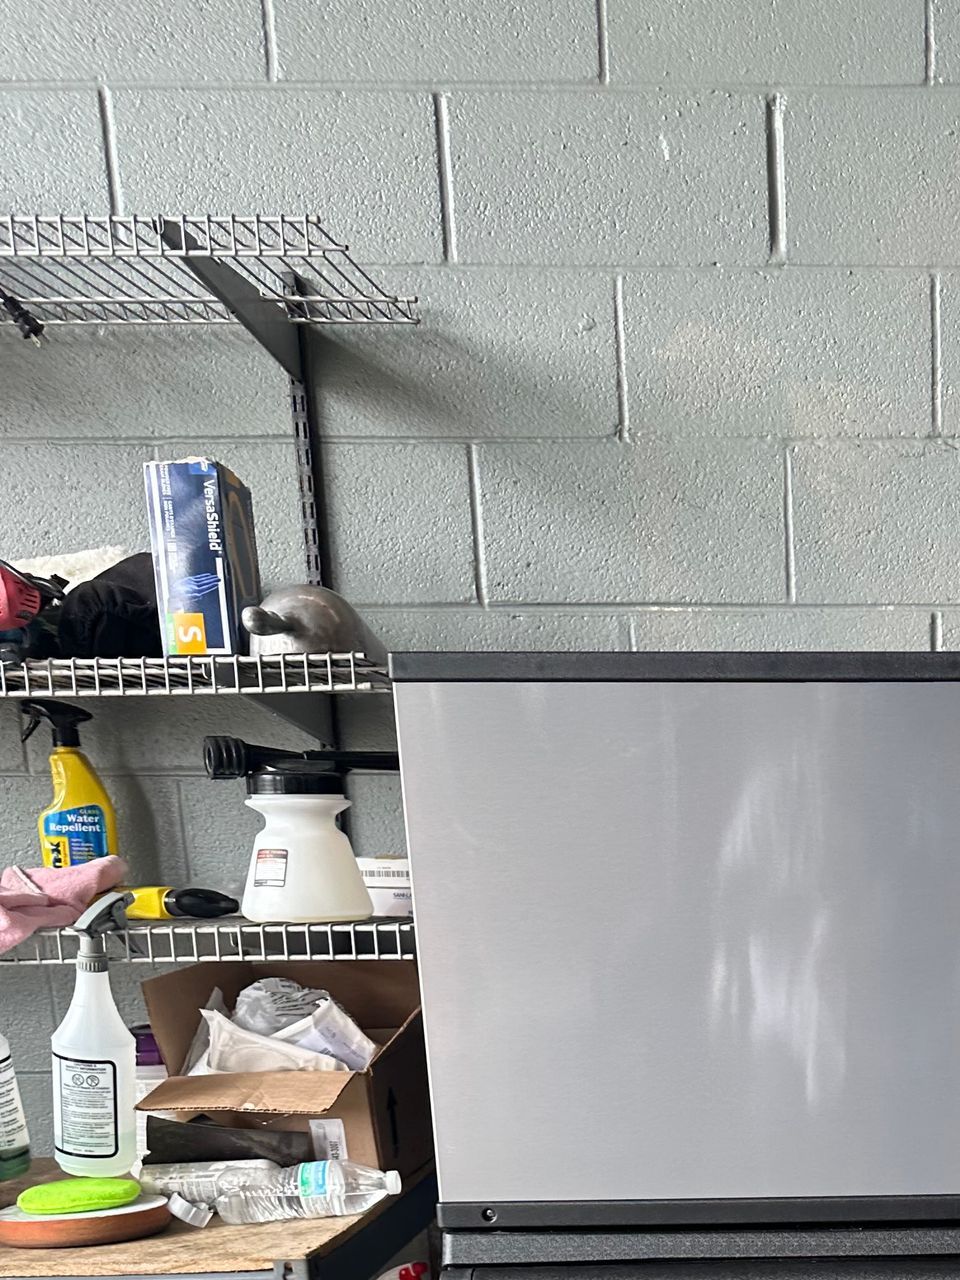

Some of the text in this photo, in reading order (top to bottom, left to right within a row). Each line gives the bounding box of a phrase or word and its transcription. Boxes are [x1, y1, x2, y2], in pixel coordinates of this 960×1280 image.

[203, 480, 222, 551] VersaShield
[178, 626, 202, 643] S
[66, 814, 100, 823] Water
[49, 823, 100, 833] Repellent
